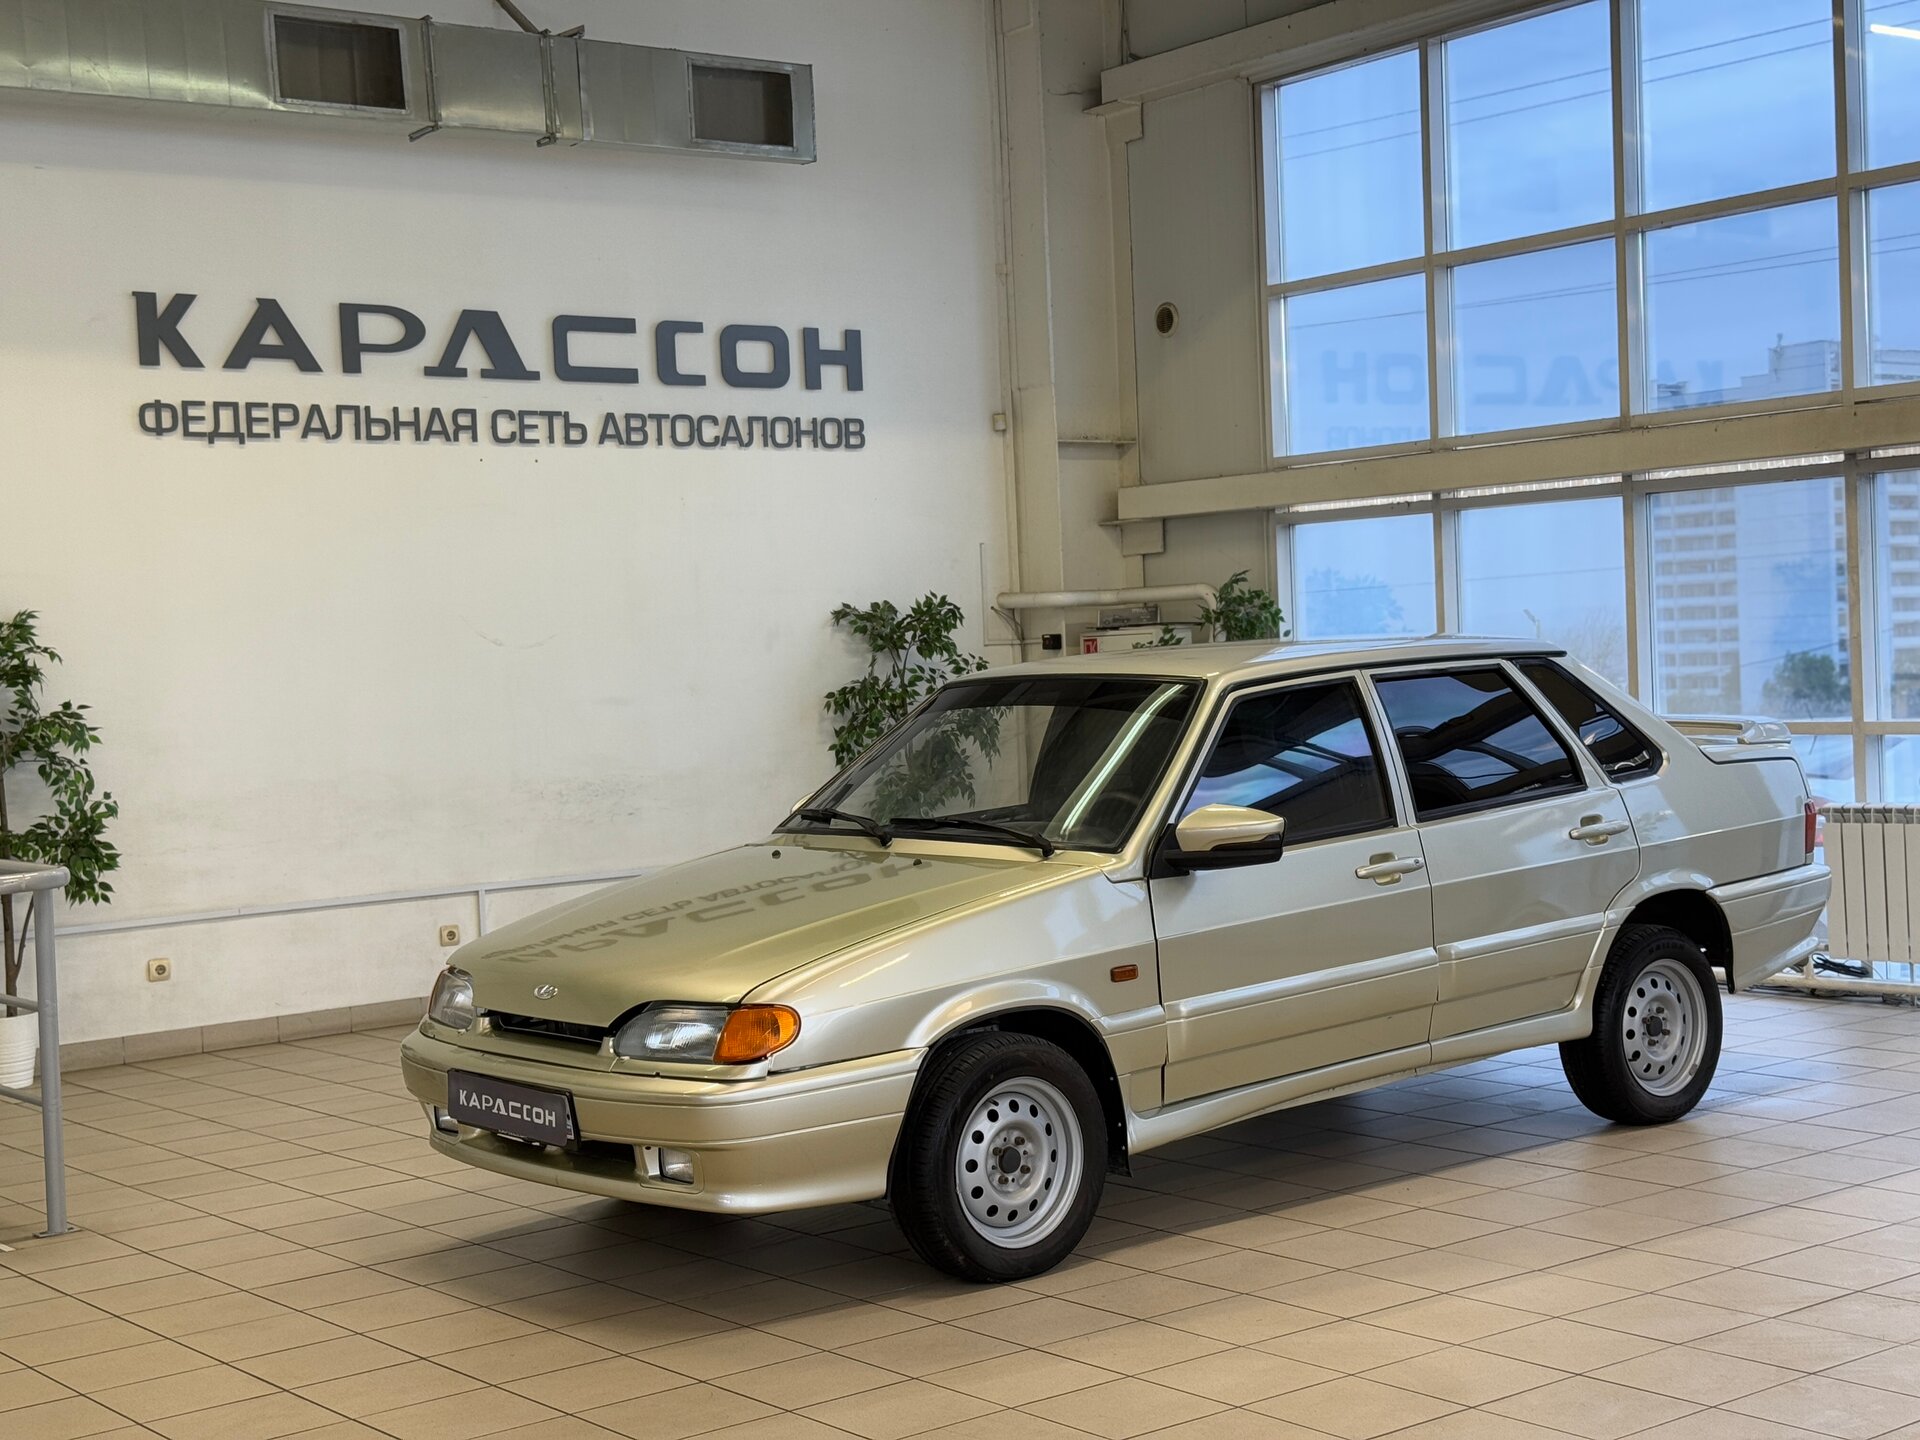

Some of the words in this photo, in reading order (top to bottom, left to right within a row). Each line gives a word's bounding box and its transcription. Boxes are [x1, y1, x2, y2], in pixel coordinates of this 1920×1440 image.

[138, 399, 479, 445] ФЕДЕРАЛЬНАЯ
[490, 409, 588, 446] СЕТЬ
[598, 412, 866, 450] АВТОСАЛОНОВ
